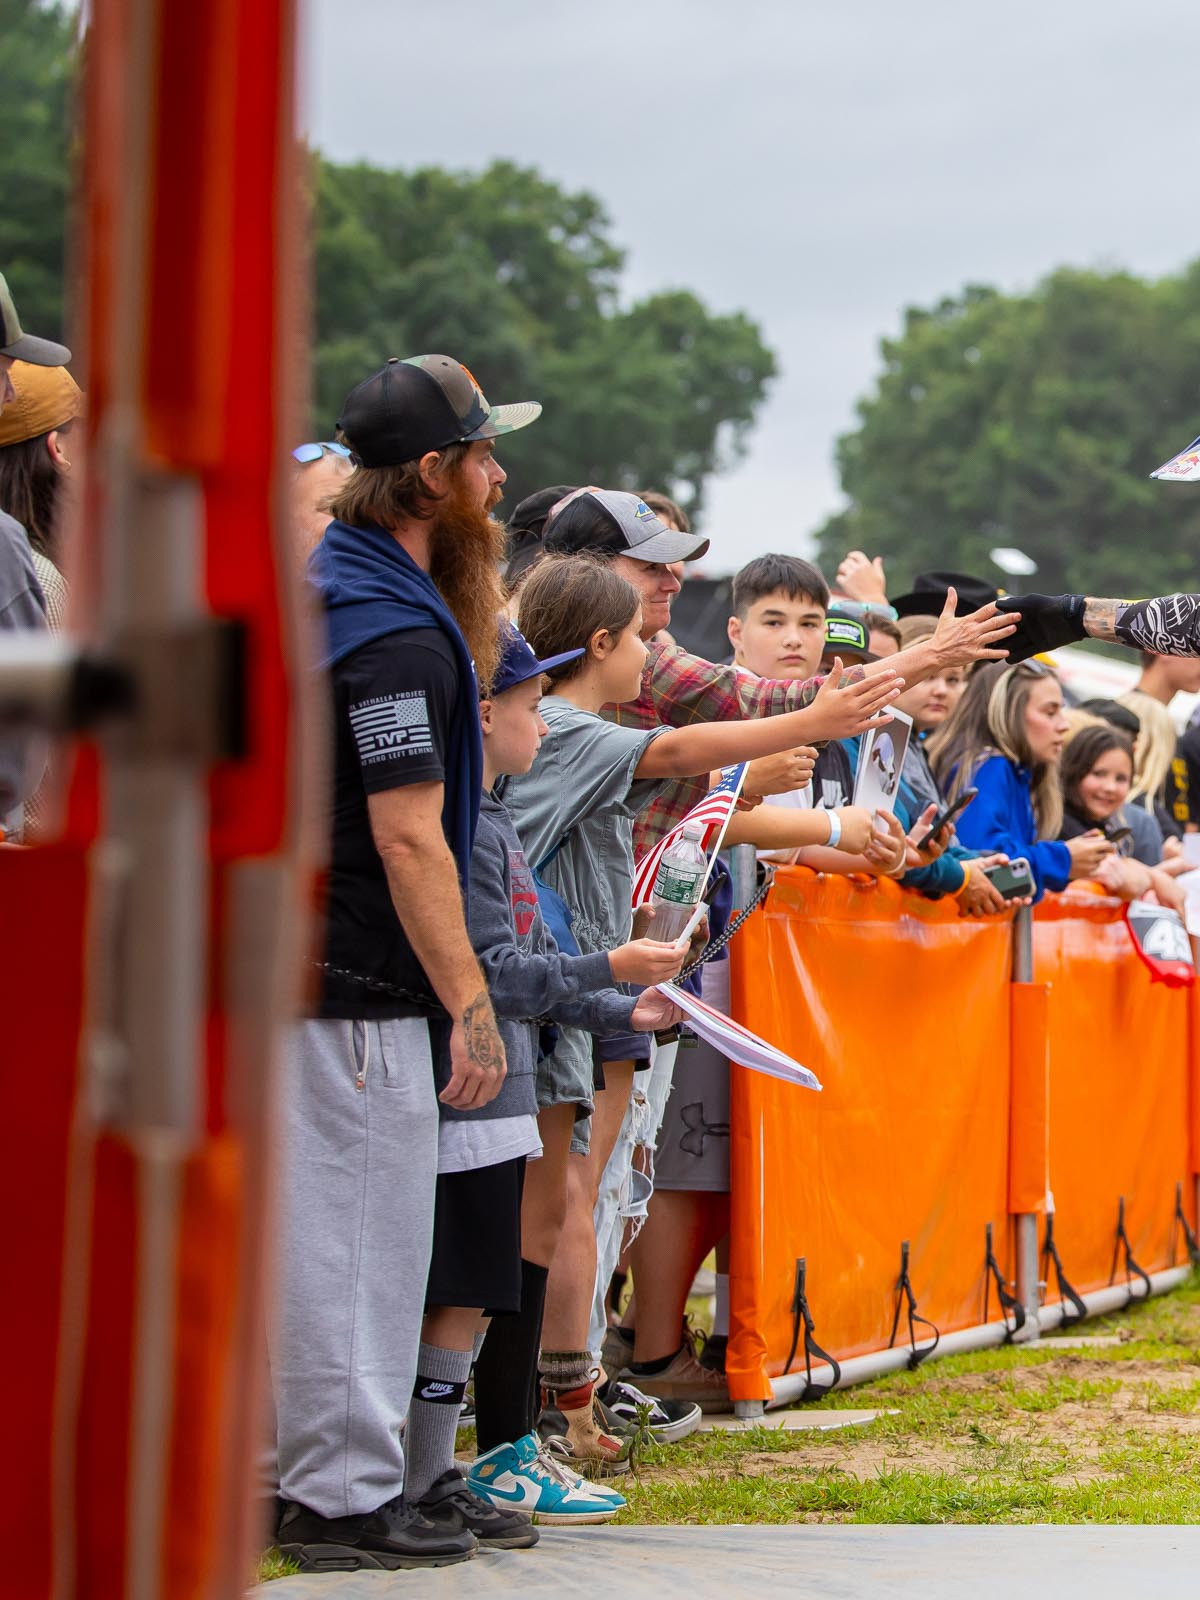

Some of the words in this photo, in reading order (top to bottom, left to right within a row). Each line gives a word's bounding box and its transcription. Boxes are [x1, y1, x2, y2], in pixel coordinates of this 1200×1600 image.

[375, 730, 408, 747] TVP
[389, 751, 406, 760] LEFT
[429, 1382, 454, 1392] NIKE
